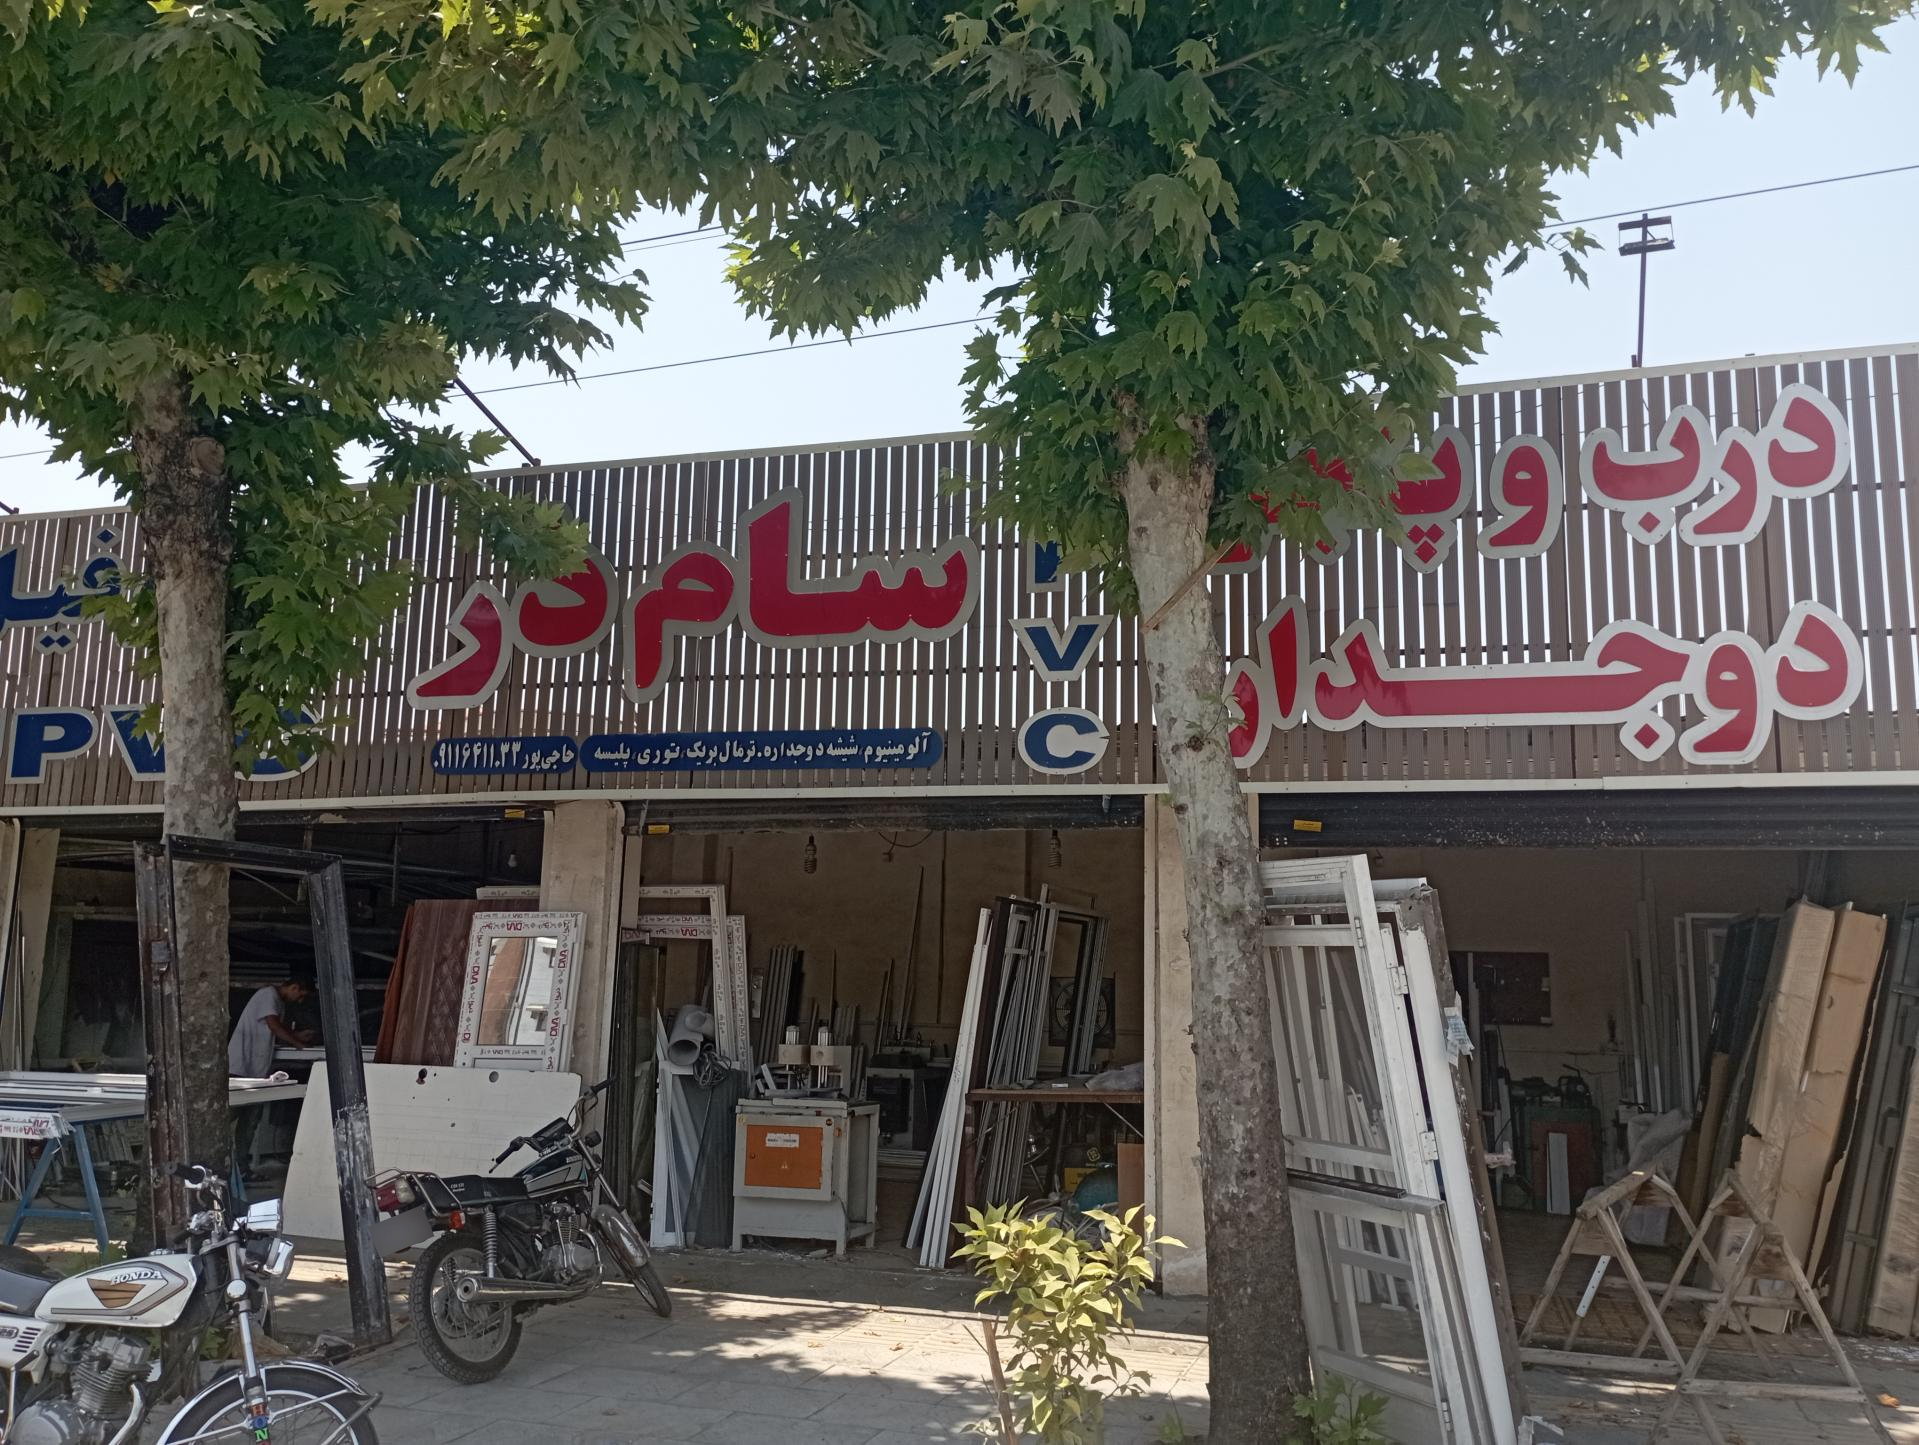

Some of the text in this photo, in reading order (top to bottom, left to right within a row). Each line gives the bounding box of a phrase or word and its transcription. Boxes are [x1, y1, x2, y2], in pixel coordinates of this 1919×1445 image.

[1586, 390, 1845, 540] درب
[627, 490, 976, 698] سام
[1228, 600, 1860, 765] دوجدار
[110, 1269, 163, 1285] HONDA
